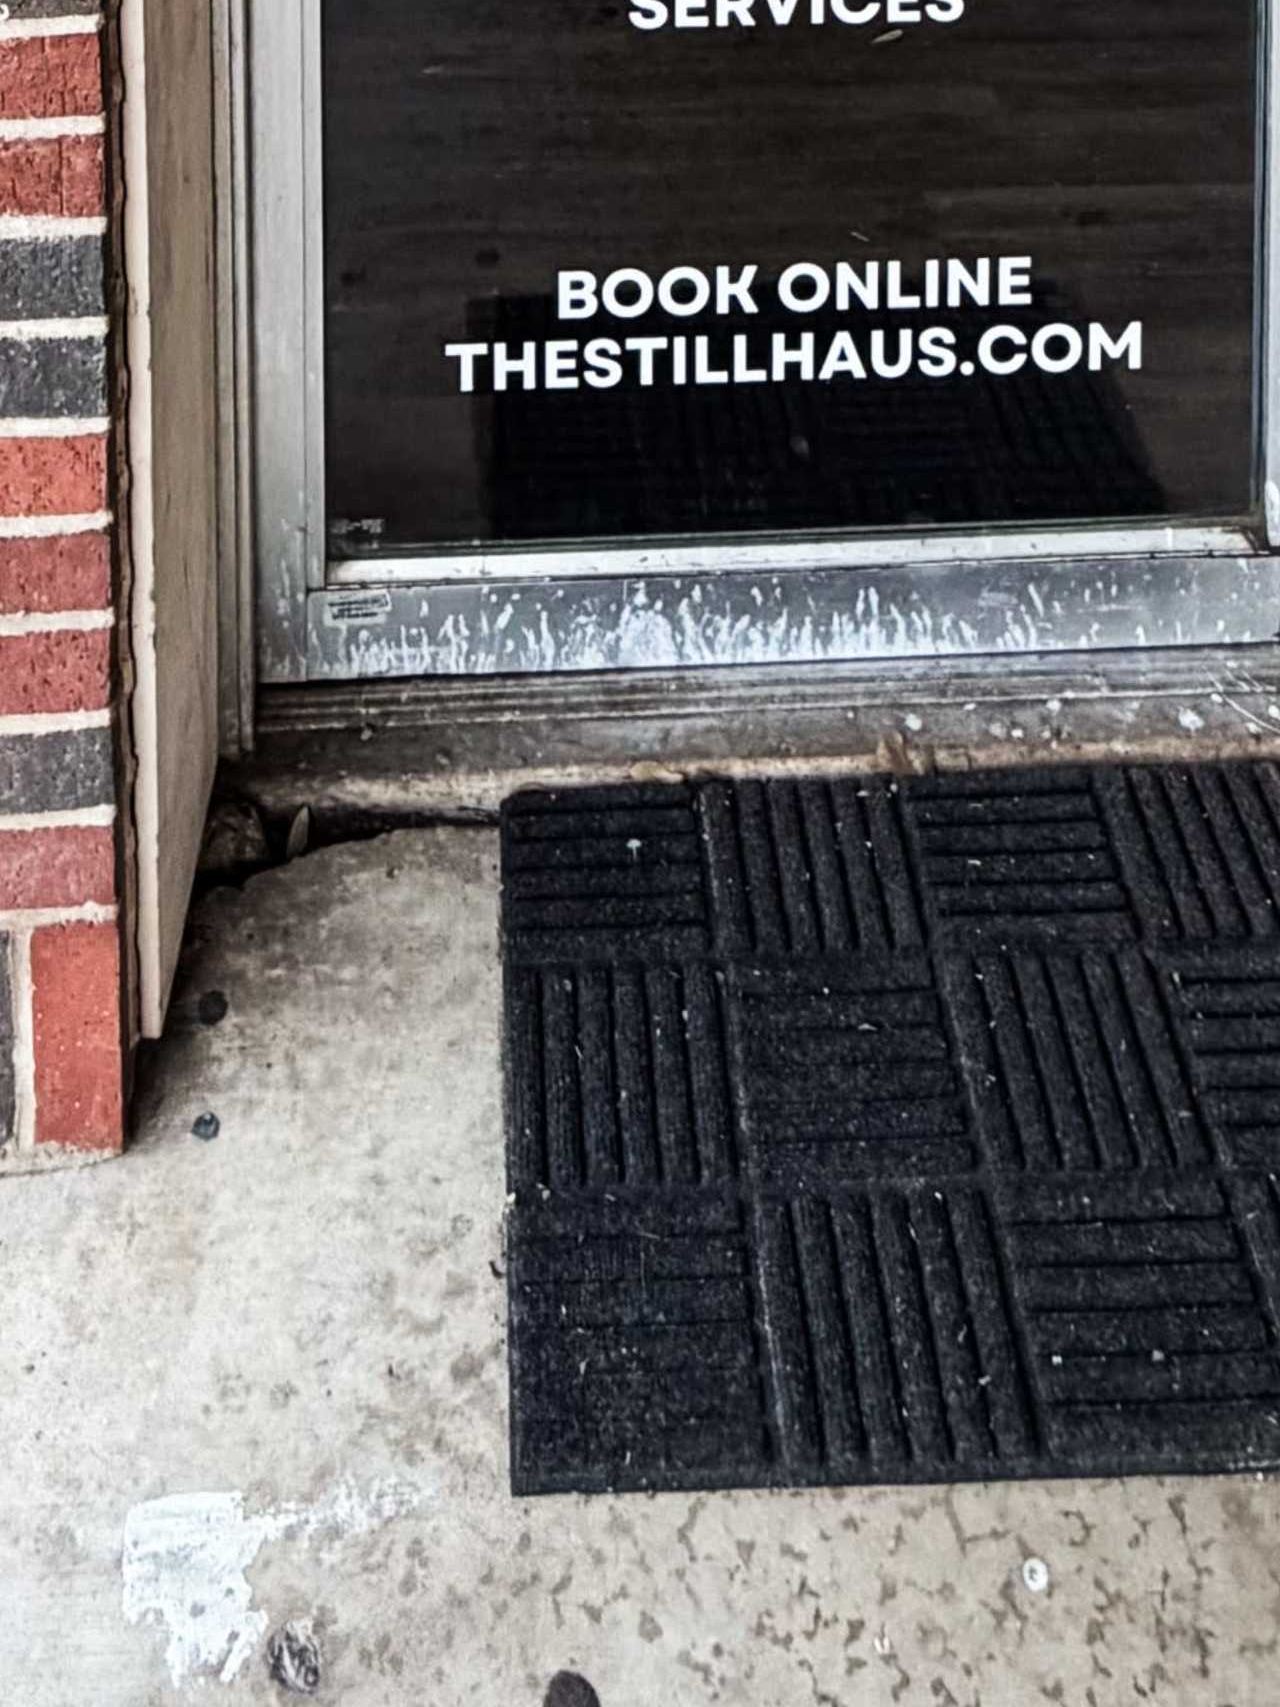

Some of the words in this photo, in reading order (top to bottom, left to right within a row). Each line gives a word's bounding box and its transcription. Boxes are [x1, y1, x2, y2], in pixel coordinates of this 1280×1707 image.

[557, 265, 759, 319] BOOK
[777, 256, 1032, 312] ONLINE
[445, 320, 1143, 392] THESTILLHAUS.COM
